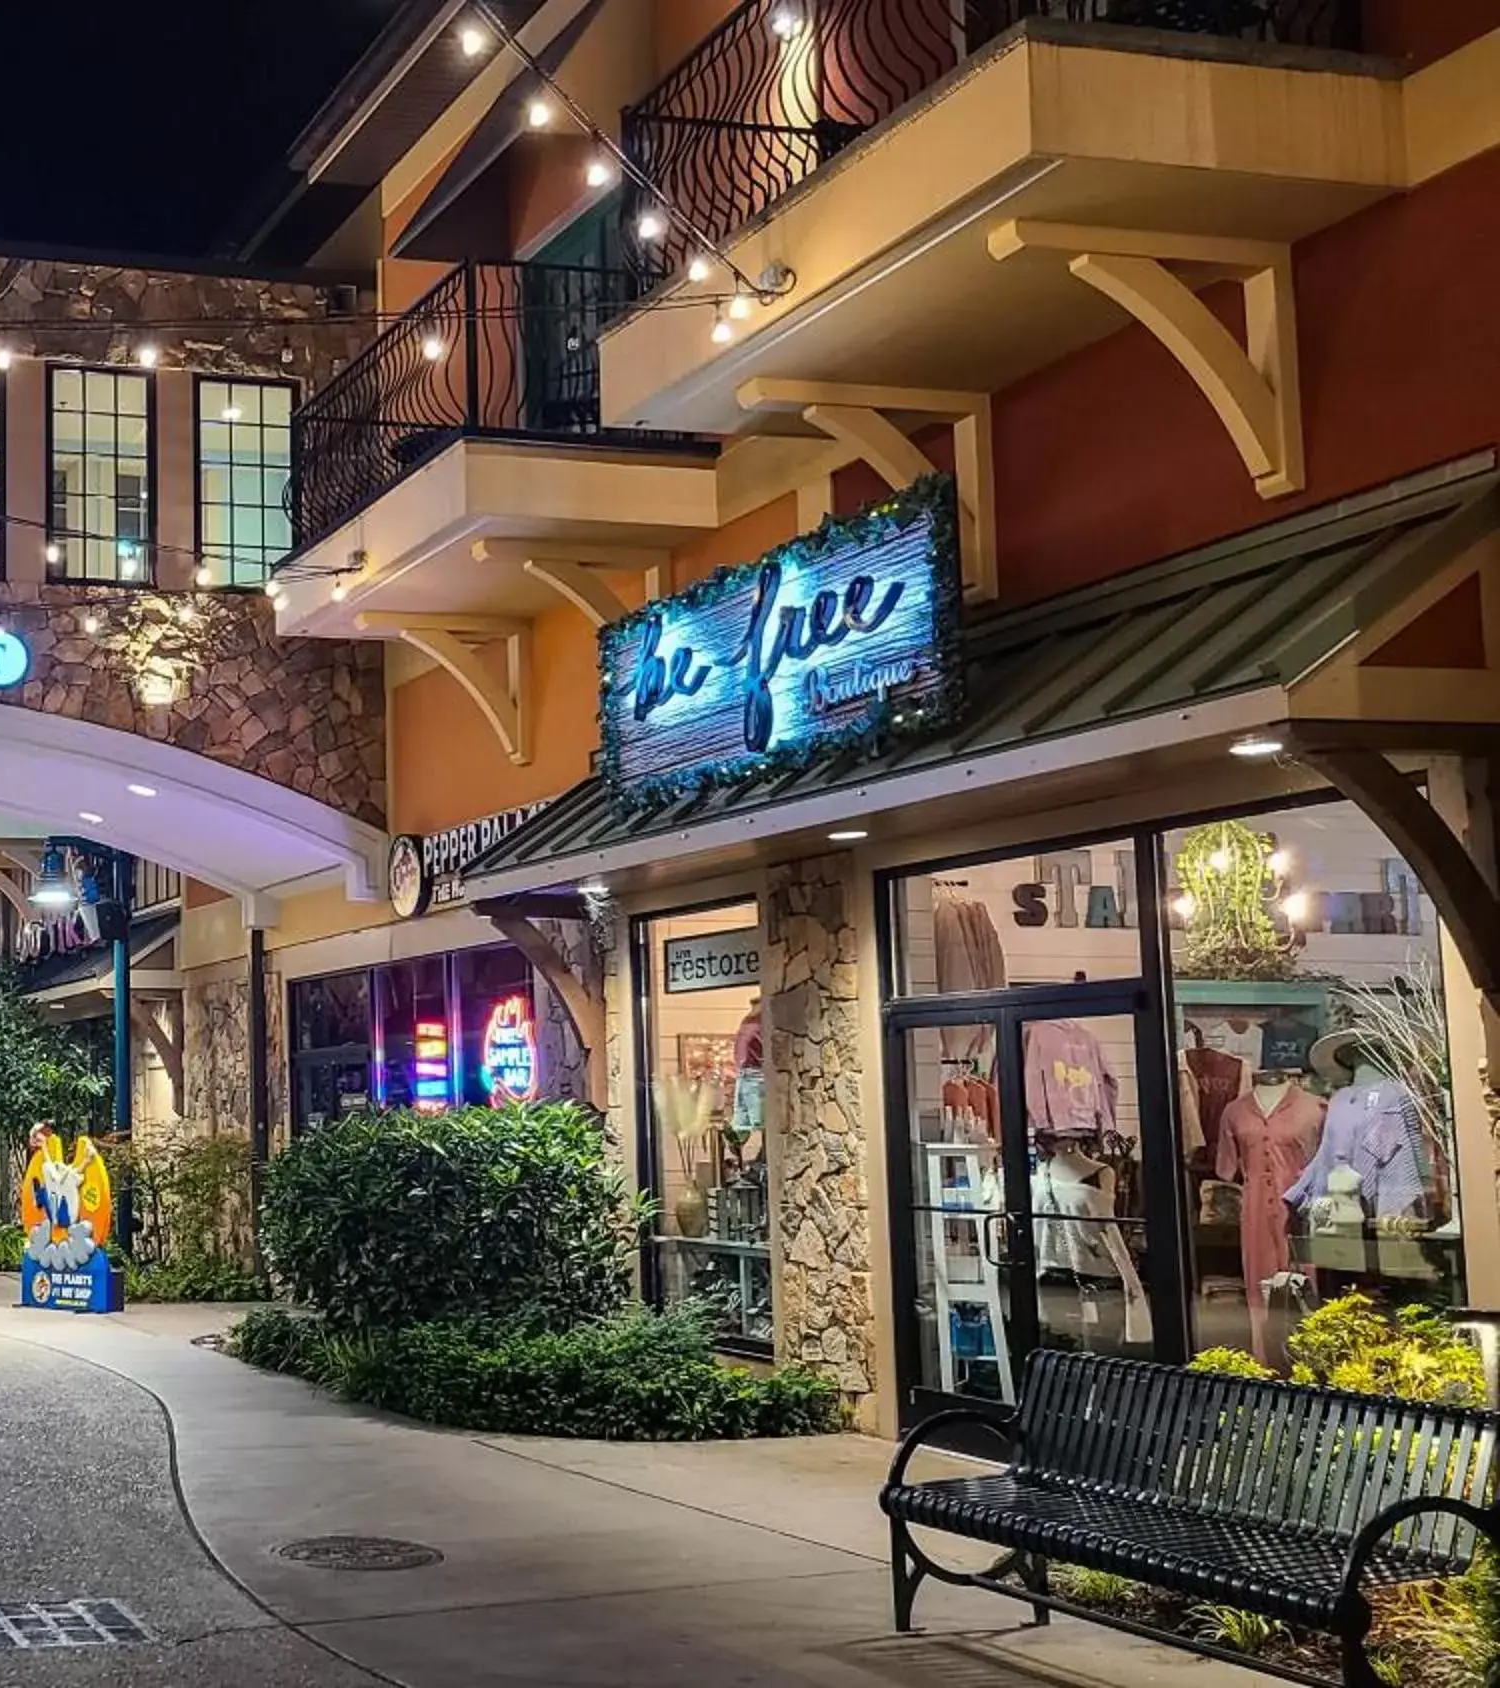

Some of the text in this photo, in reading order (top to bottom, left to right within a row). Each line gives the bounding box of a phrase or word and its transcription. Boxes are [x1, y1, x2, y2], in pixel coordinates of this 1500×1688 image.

[619, 562, 905, 753] be free
[802, 658, 913, 714] Boutique
[422, 801, 550, 878] PEPPER PALA
[431, 882, 451, 903] THE
[670, 950, 760, 982] restore
[486, 1047, 531, 1067] SAMPLE
[51, 1273, 63, 1285] THE
